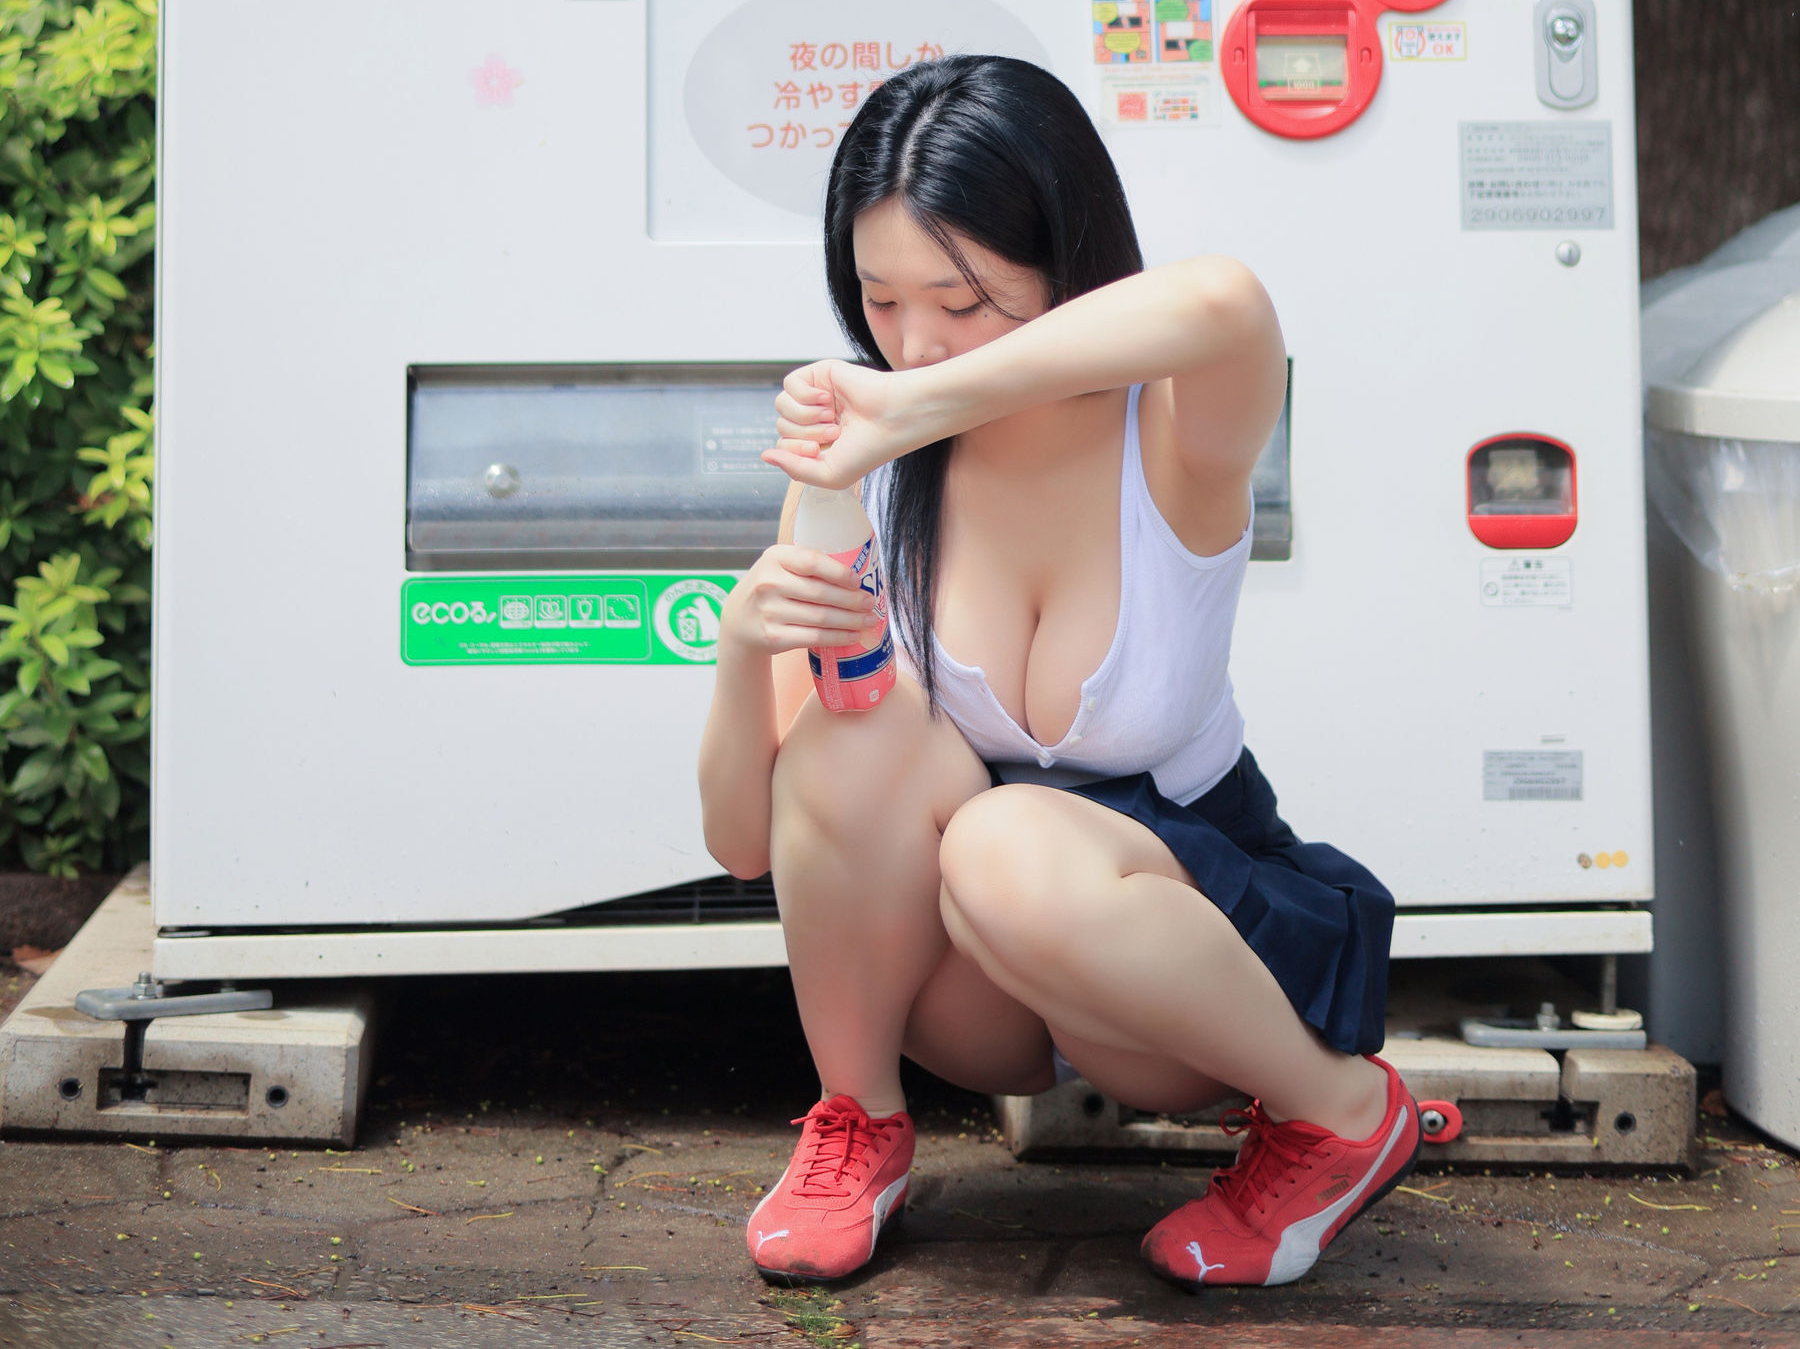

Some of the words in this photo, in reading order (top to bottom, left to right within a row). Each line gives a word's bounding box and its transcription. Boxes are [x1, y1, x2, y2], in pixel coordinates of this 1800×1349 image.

[1433, 42, 1455, 56] OK
[745, 121, 849, 150] つかっ
[859, 564, 884, 598] Sk
[1315, 1178, 1349, 1204] PUMA
